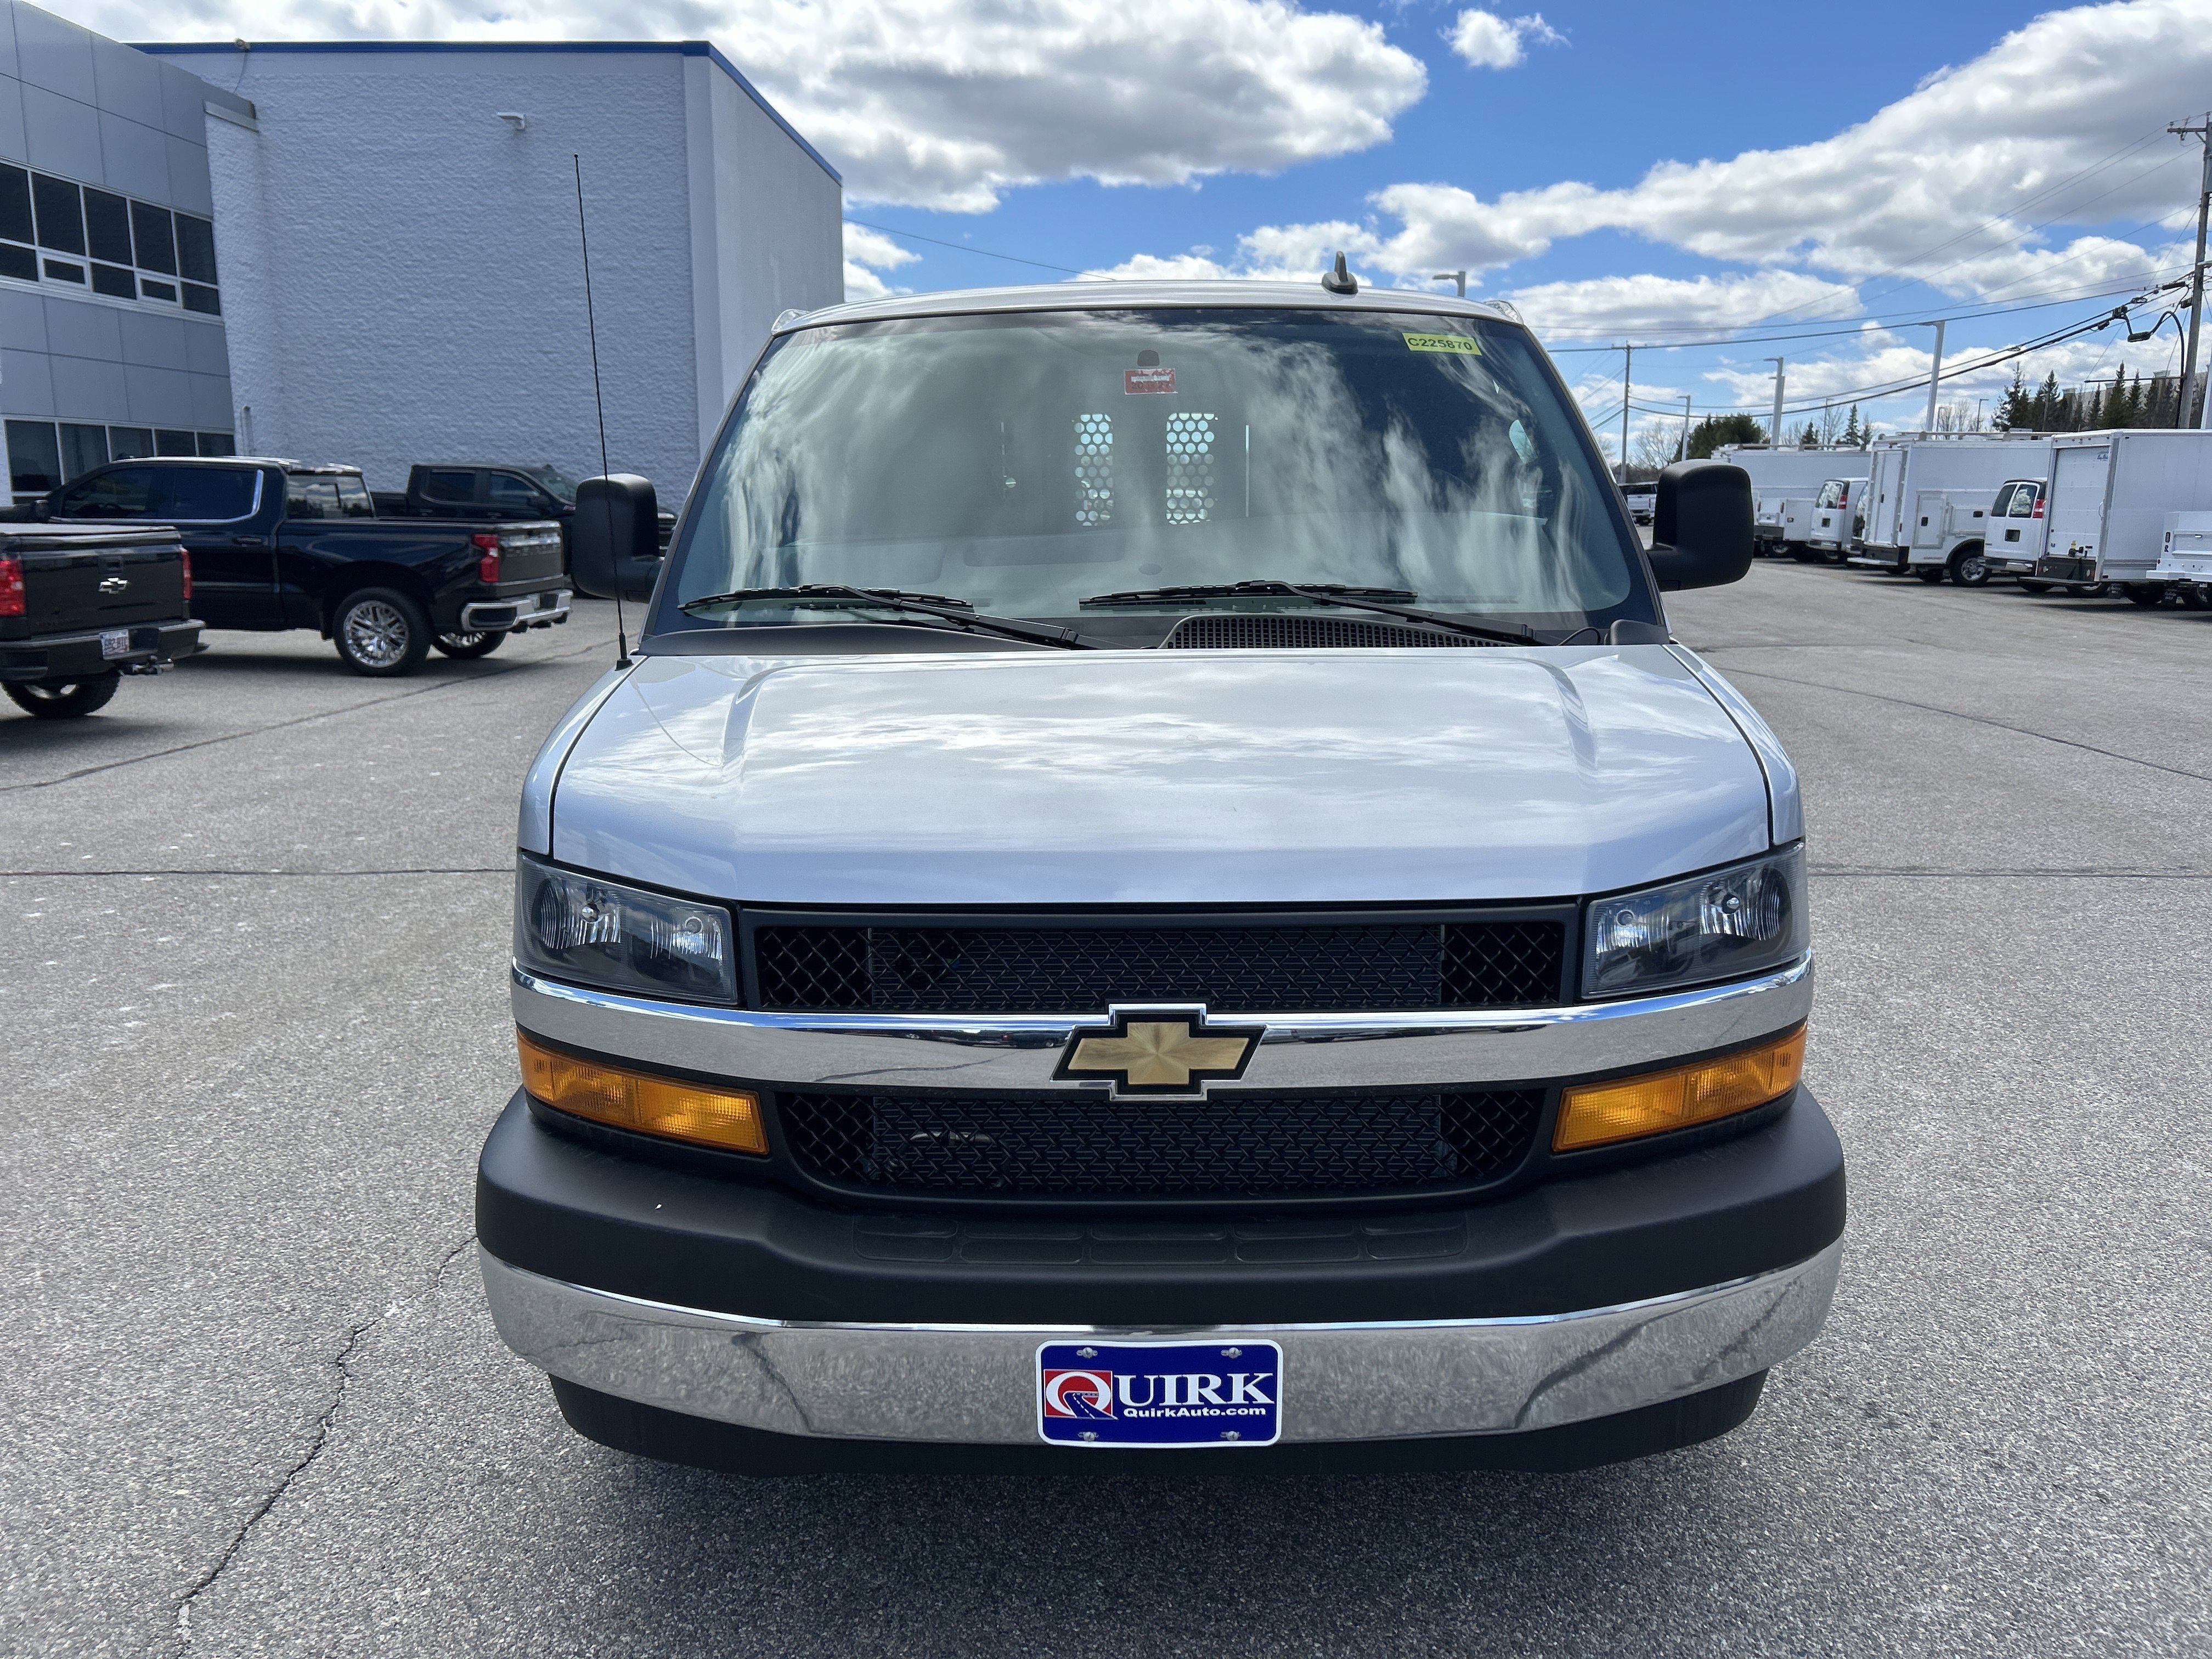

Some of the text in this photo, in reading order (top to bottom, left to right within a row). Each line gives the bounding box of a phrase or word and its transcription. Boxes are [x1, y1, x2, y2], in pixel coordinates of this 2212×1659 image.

[1407, 337, 1473, 351] C225870
[1045, 1371, 1275, 1420] QUIRK
[1123, 1407, 1266, 1418] QuirkAuto.com
